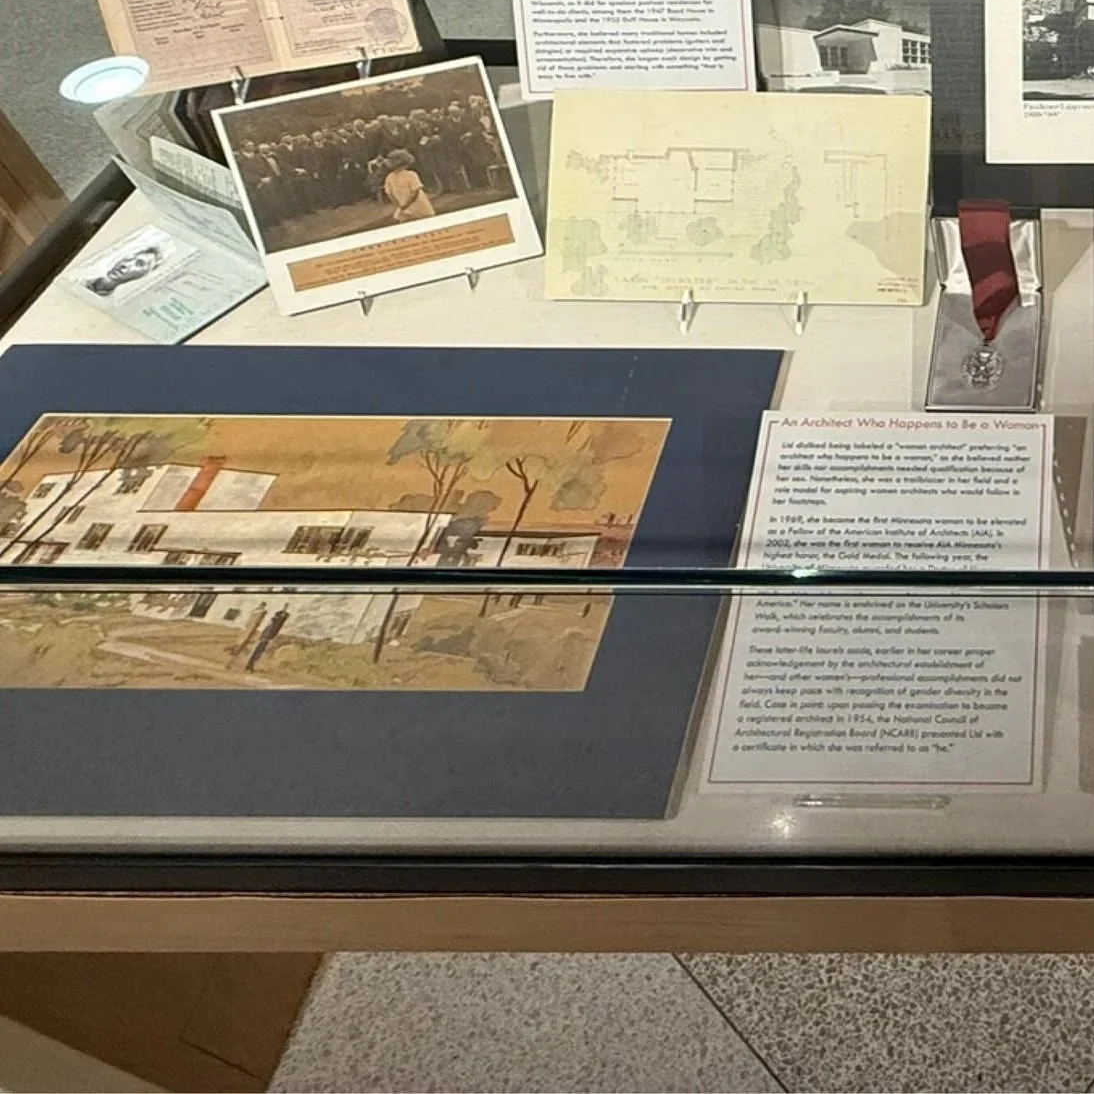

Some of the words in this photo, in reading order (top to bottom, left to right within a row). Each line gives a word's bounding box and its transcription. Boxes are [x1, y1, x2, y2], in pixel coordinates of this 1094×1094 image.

[781, 417, 798, 426] An
[800, 418, 853, 427] Architect
[857, 418, 885, 427] Who
[888, 418, 943, 430] Happens
[946, 420, 958, 429] to
[961, 419, 976, 429] Be
[993, 420, 1040, 430] Woman
